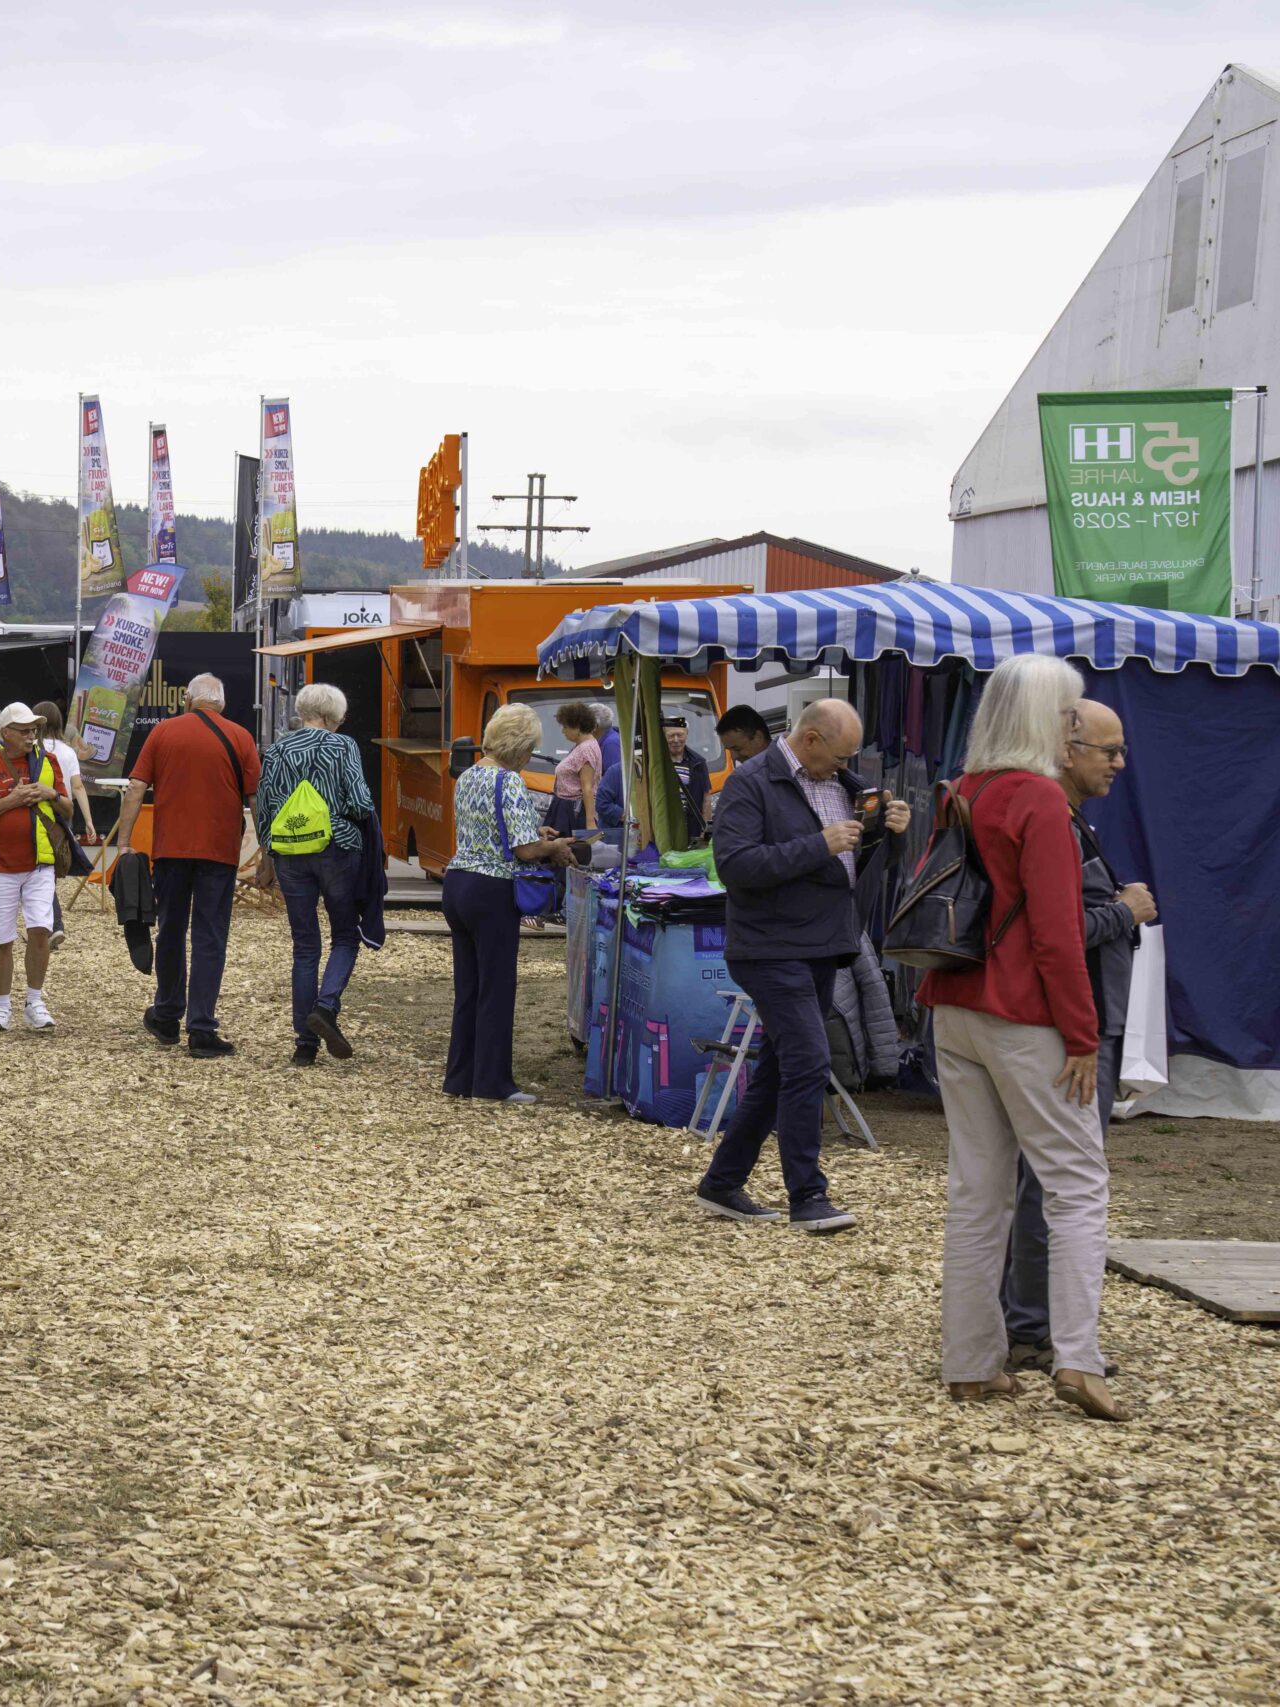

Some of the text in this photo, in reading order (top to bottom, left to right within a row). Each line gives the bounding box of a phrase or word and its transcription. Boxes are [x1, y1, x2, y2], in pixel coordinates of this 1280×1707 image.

[140, 571, 170, 588] NEW!
[137, 583, 165, 596] TRY NOW
[342, 612, 383, 626] JOKA
[114, 617, 151, 639] KURZER
[112, 630, 145, 651] SMOKE,
[102, 640, 147, 664] FRUCHTIG
[103, 654, 140, 674] LANGER
[107, 667, 129, 685] VIBE.
[135, 717, 160, 725] CIGARS
[87, 725, 112, 737] Rauchen
[701, 968, 726, 980] DIE
